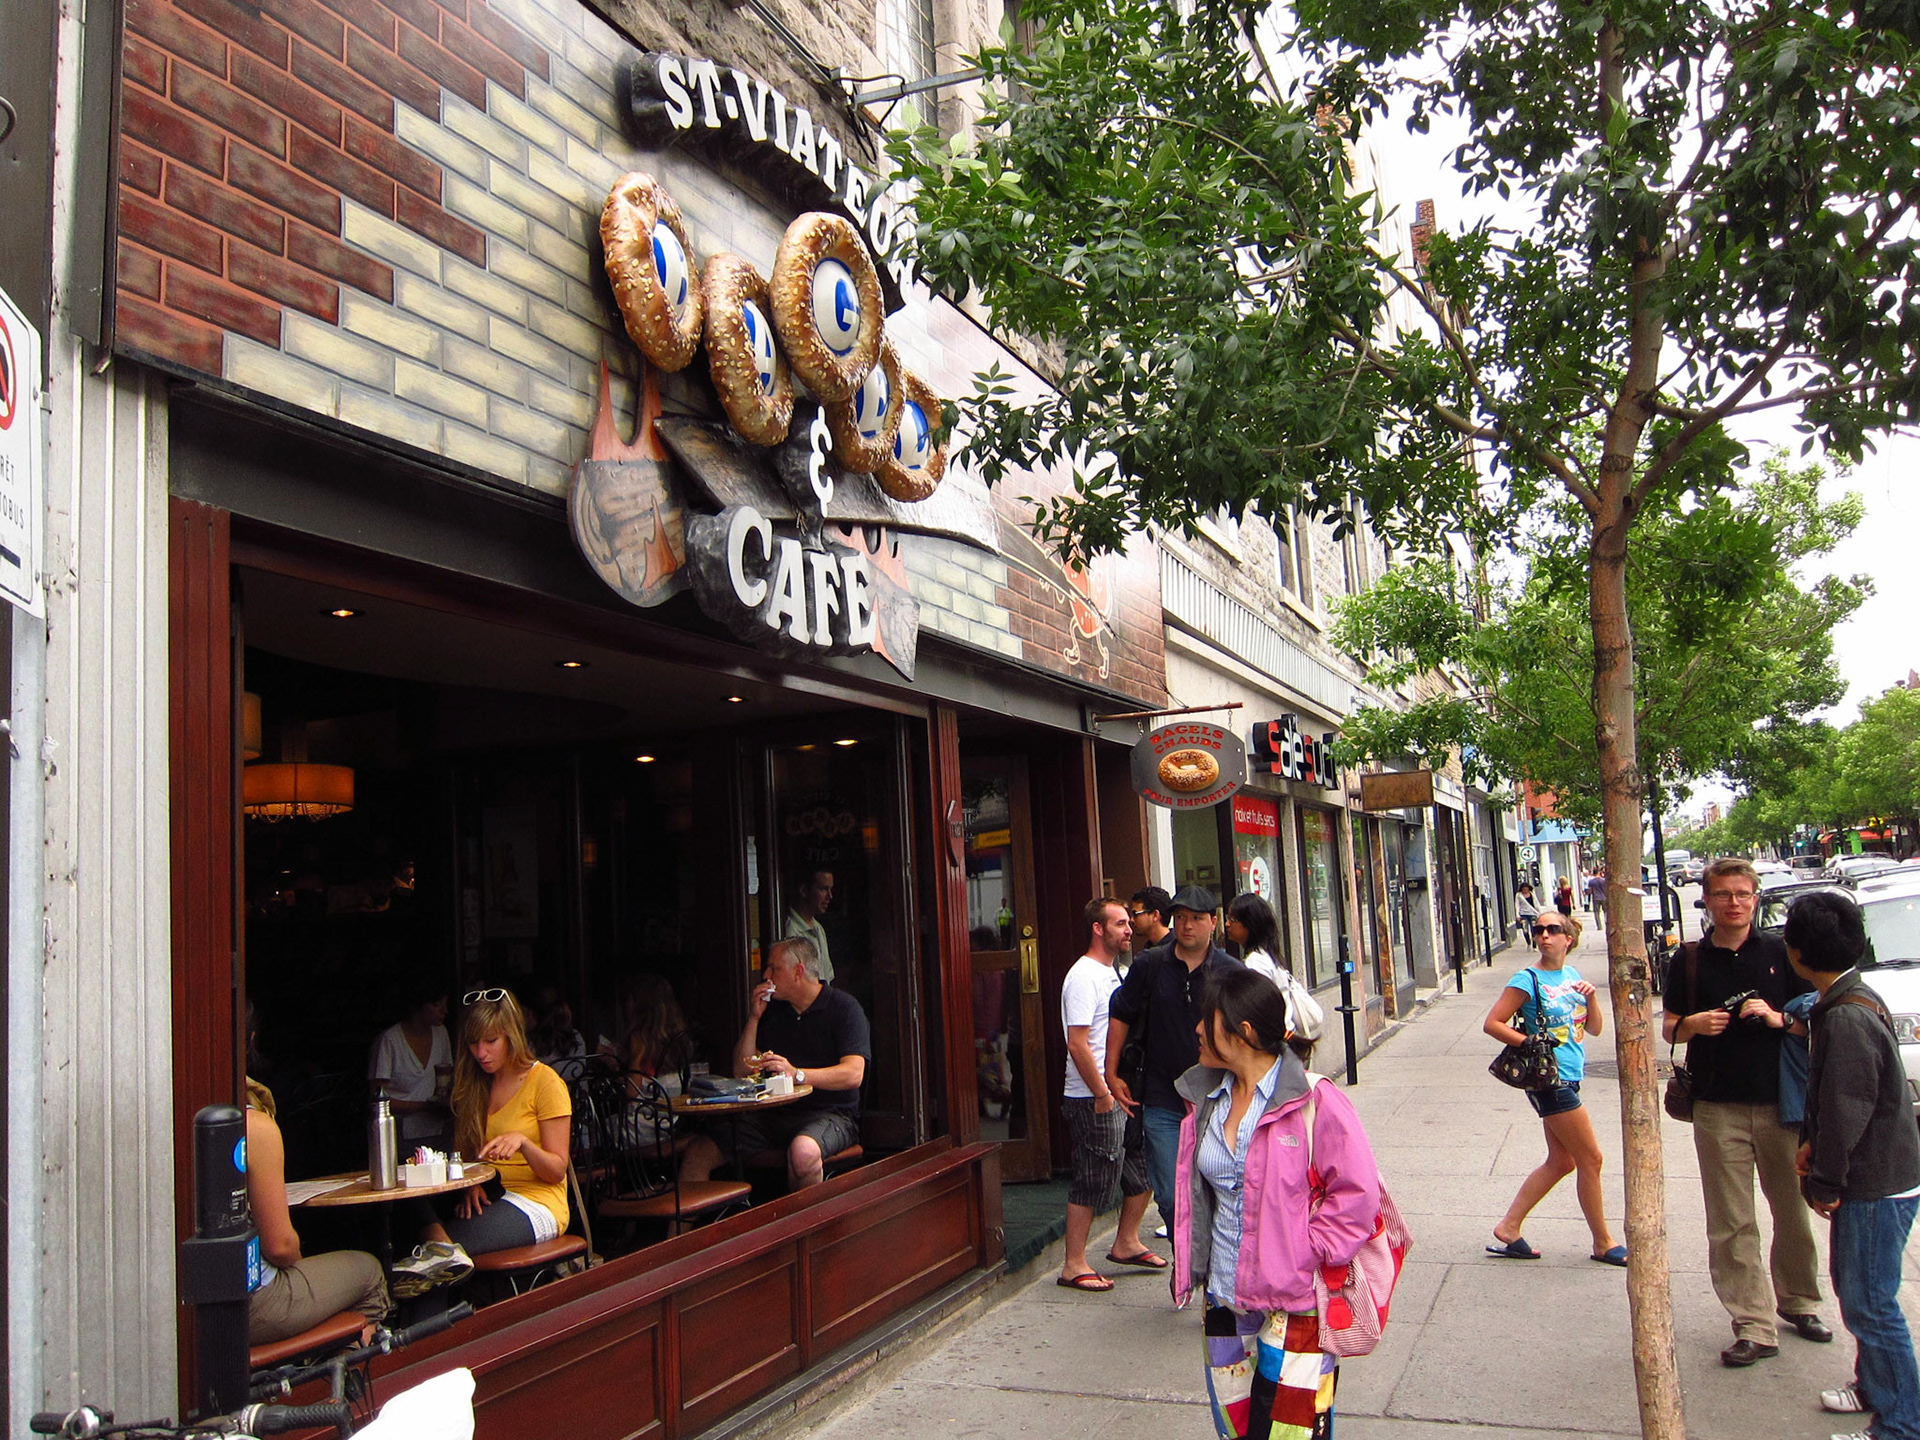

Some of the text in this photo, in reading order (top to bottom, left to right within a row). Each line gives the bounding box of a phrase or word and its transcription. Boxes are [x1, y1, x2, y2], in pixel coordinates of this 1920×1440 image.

[1149, 725, 1224, 745] BAGELS
[1154, 736, 1222, 754] CHAUDS
[1143, 781, 1236, 806] POUR EMPORTER
